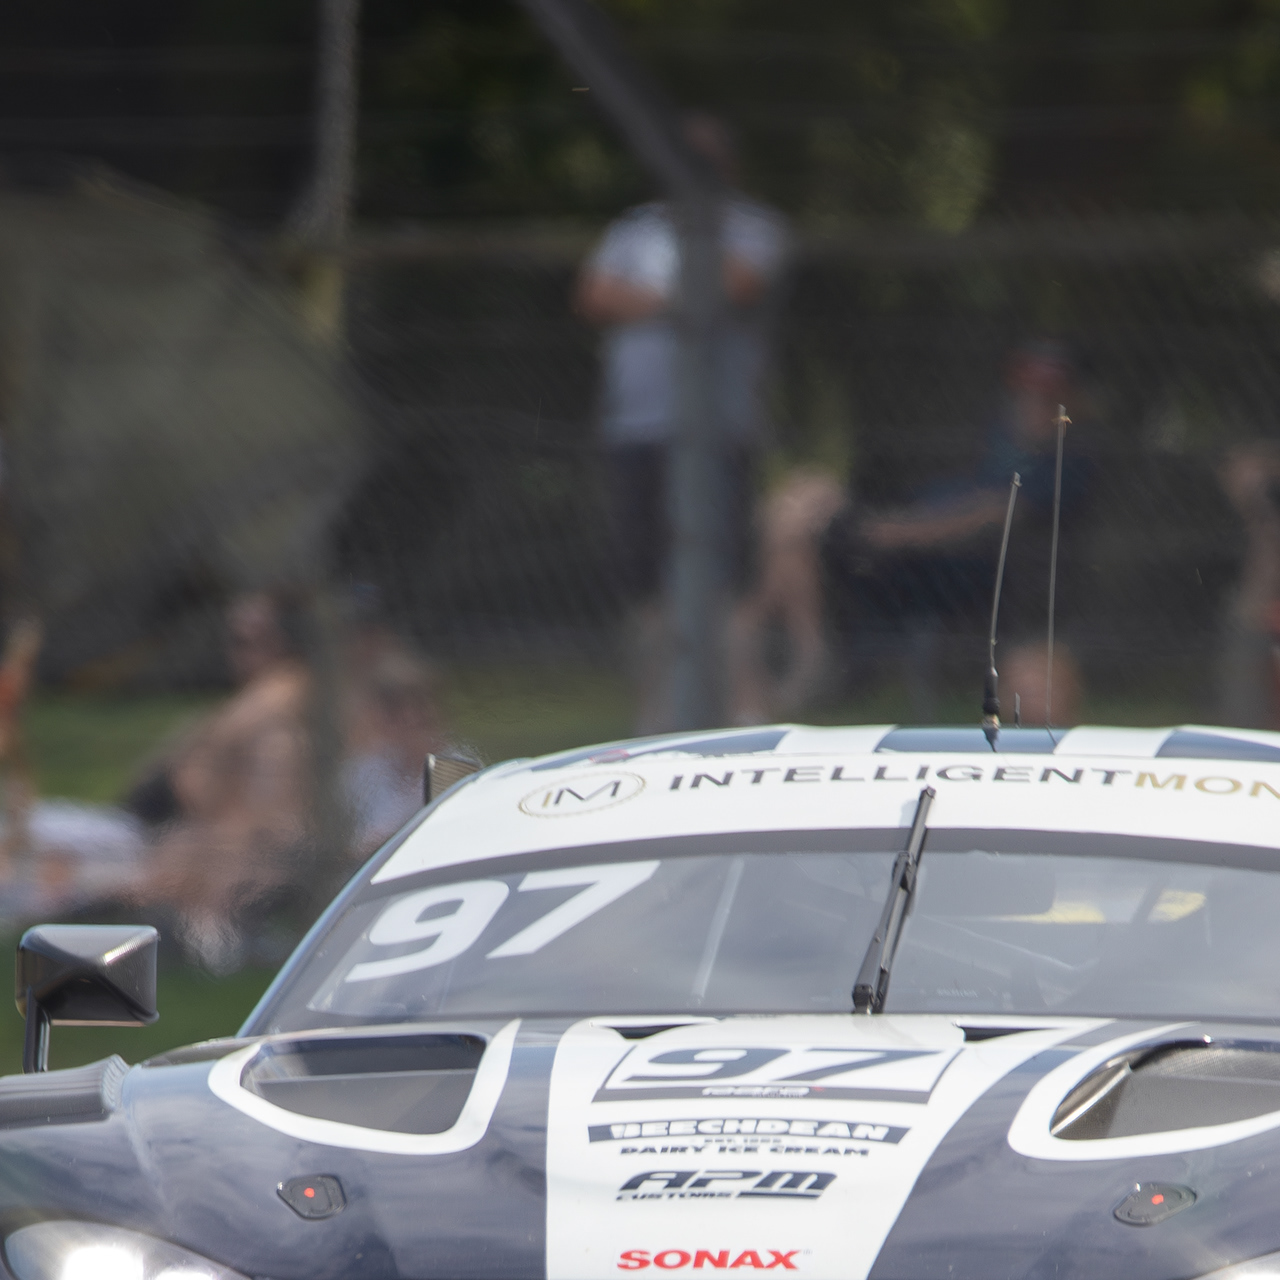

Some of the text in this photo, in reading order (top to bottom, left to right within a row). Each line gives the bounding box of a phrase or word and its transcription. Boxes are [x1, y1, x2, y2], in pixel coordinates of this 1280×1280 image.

[347, 861, 659, 981] 97
[622, 1048, 941, 1081] 97
[610, 1118, 890, 1141] BEECHDEAN
[620, 1144, 869, 1156] DAIRY ICE CREAM
[617, 1249, 802, 1271] SONAX
